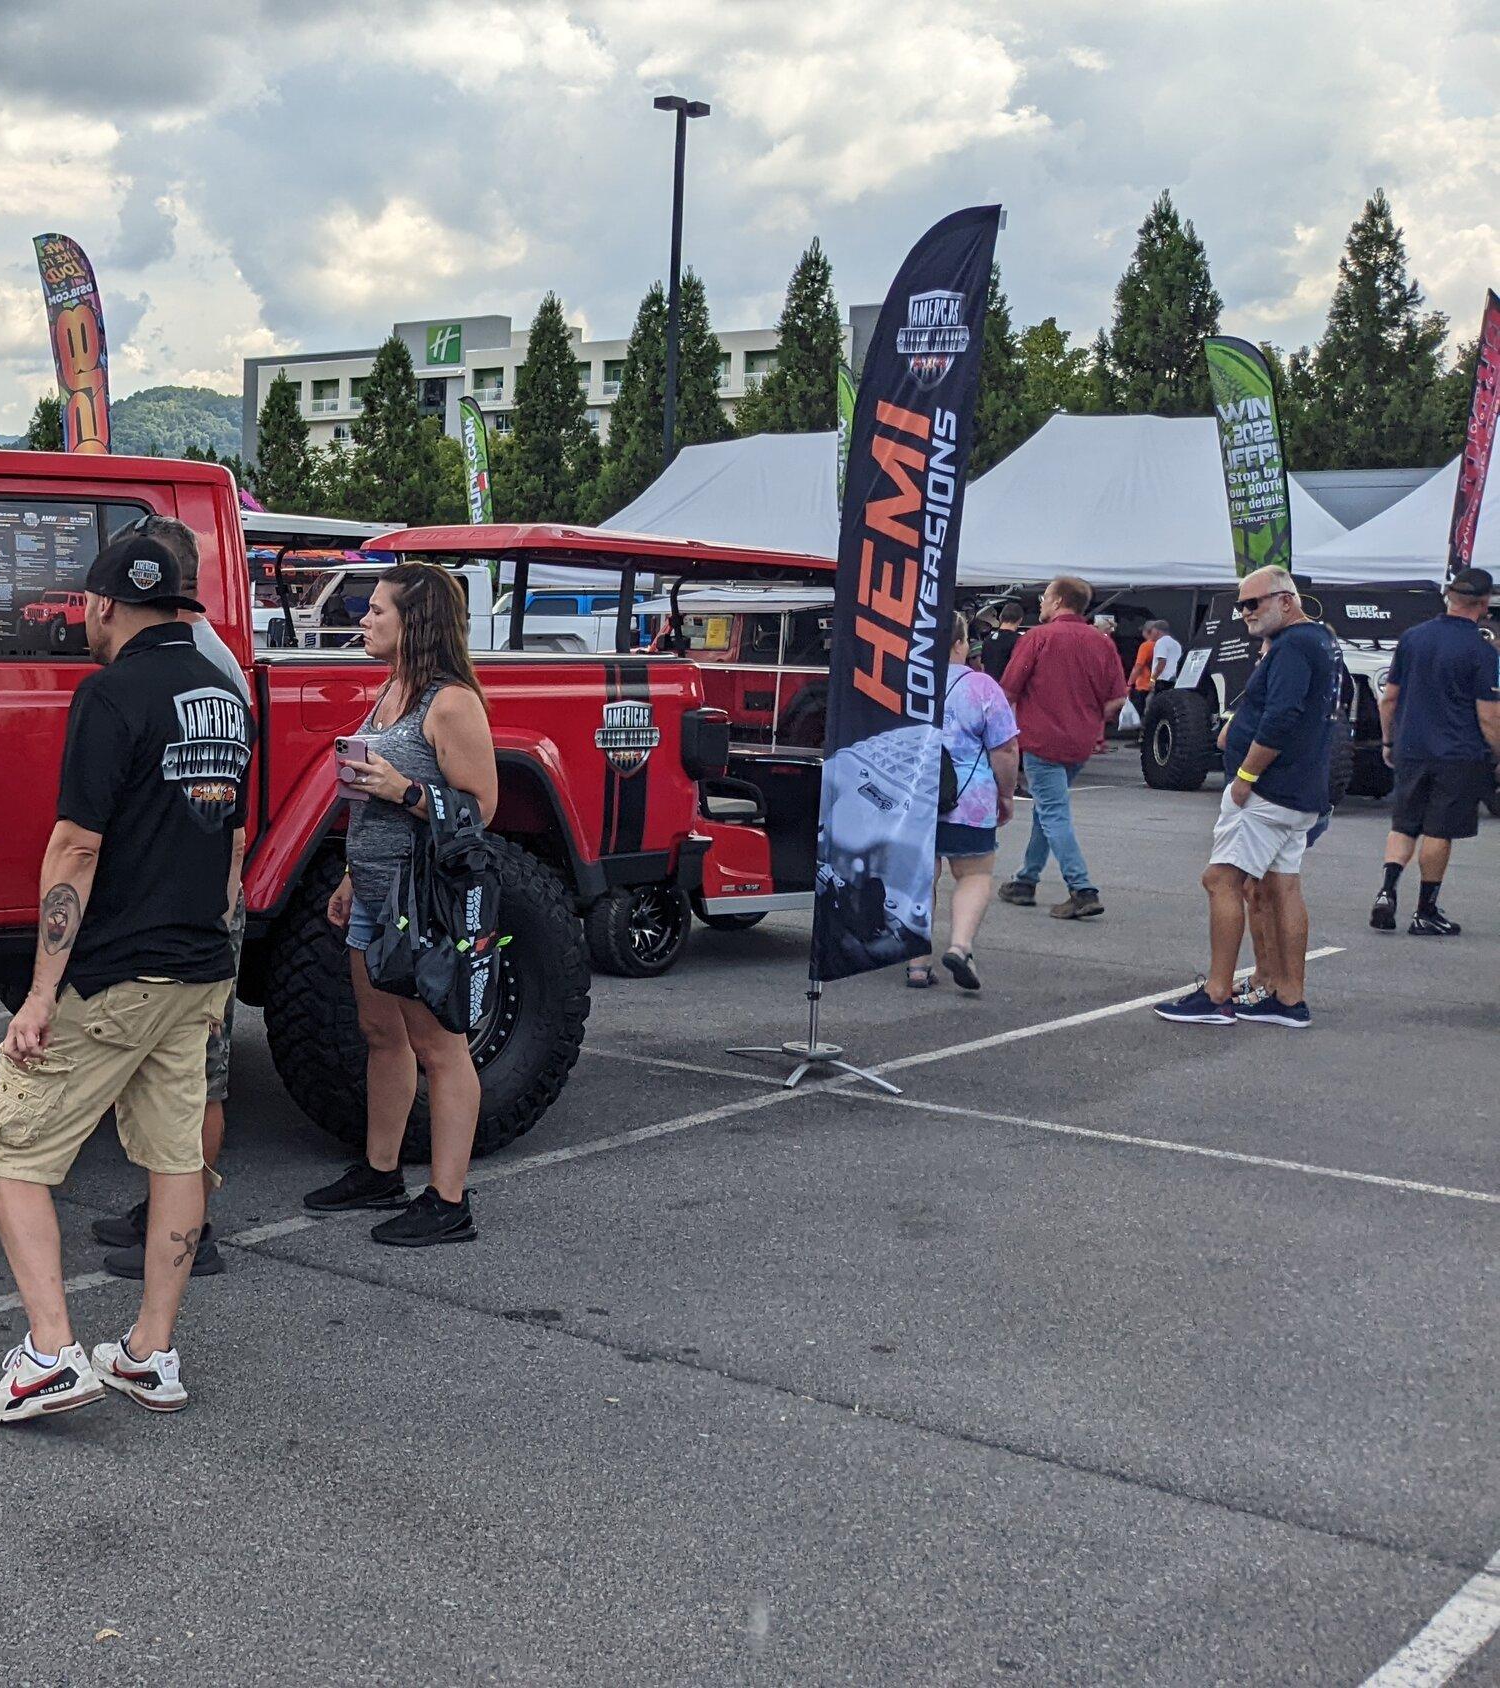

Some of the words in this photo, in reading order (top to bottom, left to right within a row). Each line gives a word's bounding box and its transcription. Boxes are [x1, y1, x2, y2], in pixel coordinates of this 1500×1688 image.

[1217, 395, 1271, 423] WIN
[1233, 420, 1274, 447] 2022
[1225, 442, 1278, 470] JEEP!
[1228, 470, 1260, 484] Stop
[1263, 466, 1280, 479] by
[1229, 487, 1246, 499] our
[1248, 479, 1283, 496] BOOTH
[1230, 501, 1246, 512] for
[1248, 494, 1284, 509] details
[853, 400, 931, 715] HEMI
[905, 407, 958, 723] CONVERSIONS
[186, 699, 246, 742] AMERICAS
[607, 706, 649, 727] AMERICAS
